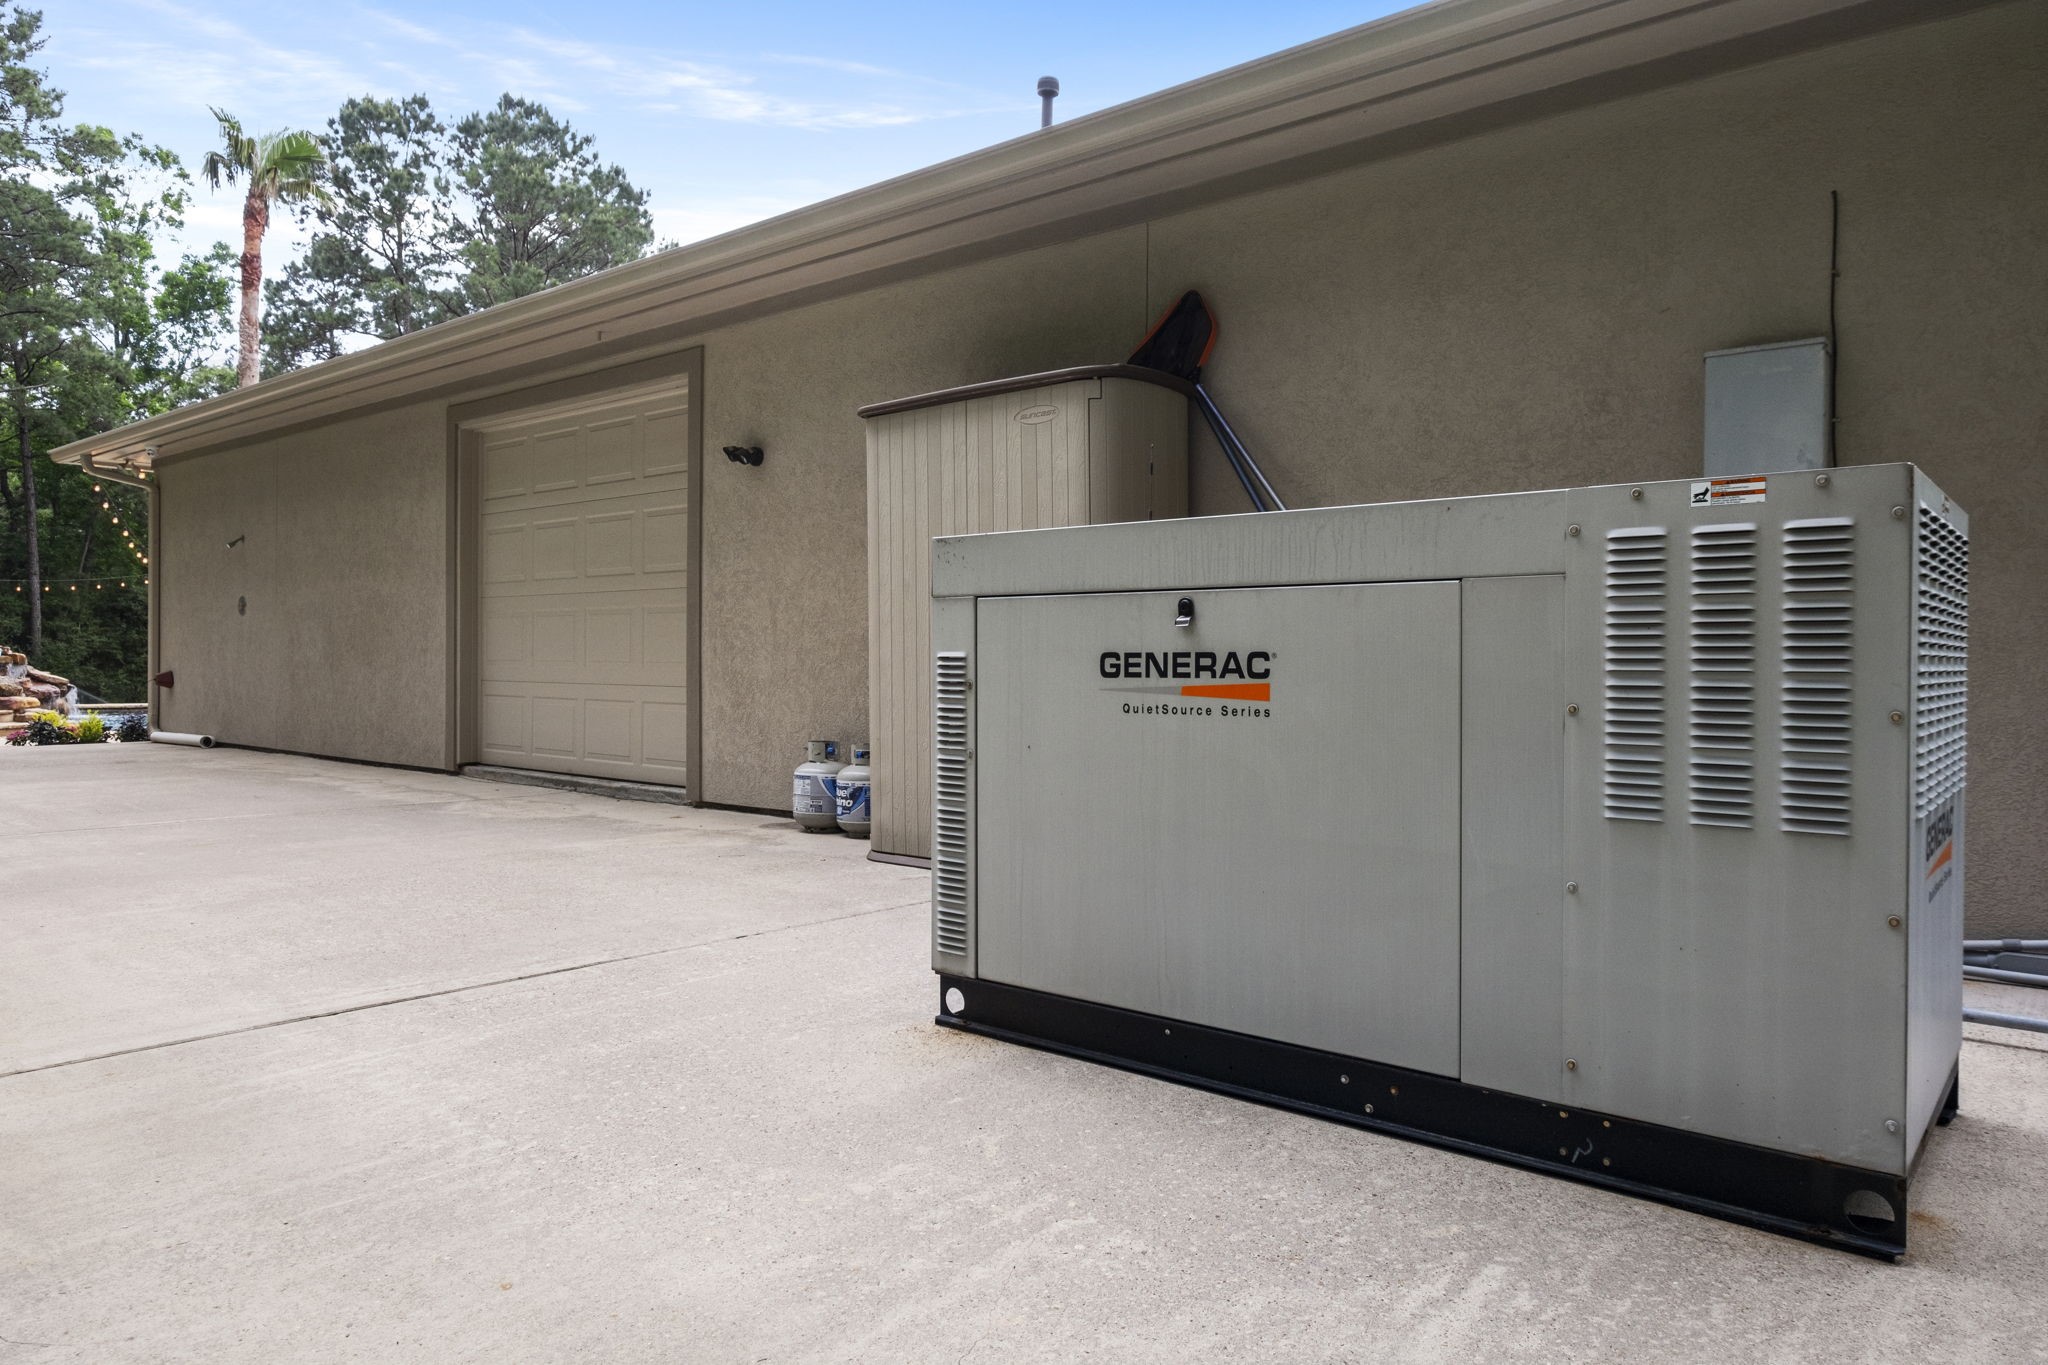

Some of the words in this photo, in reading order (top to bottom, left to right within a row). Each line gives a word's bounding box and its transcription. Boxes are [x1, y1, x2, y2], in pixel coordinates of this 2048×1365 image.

[1100, 651, 1271, 679] GENERAC
[1122, 703, 1212, 716] QuietSource
[1220, 705, 1271, 718] Series
